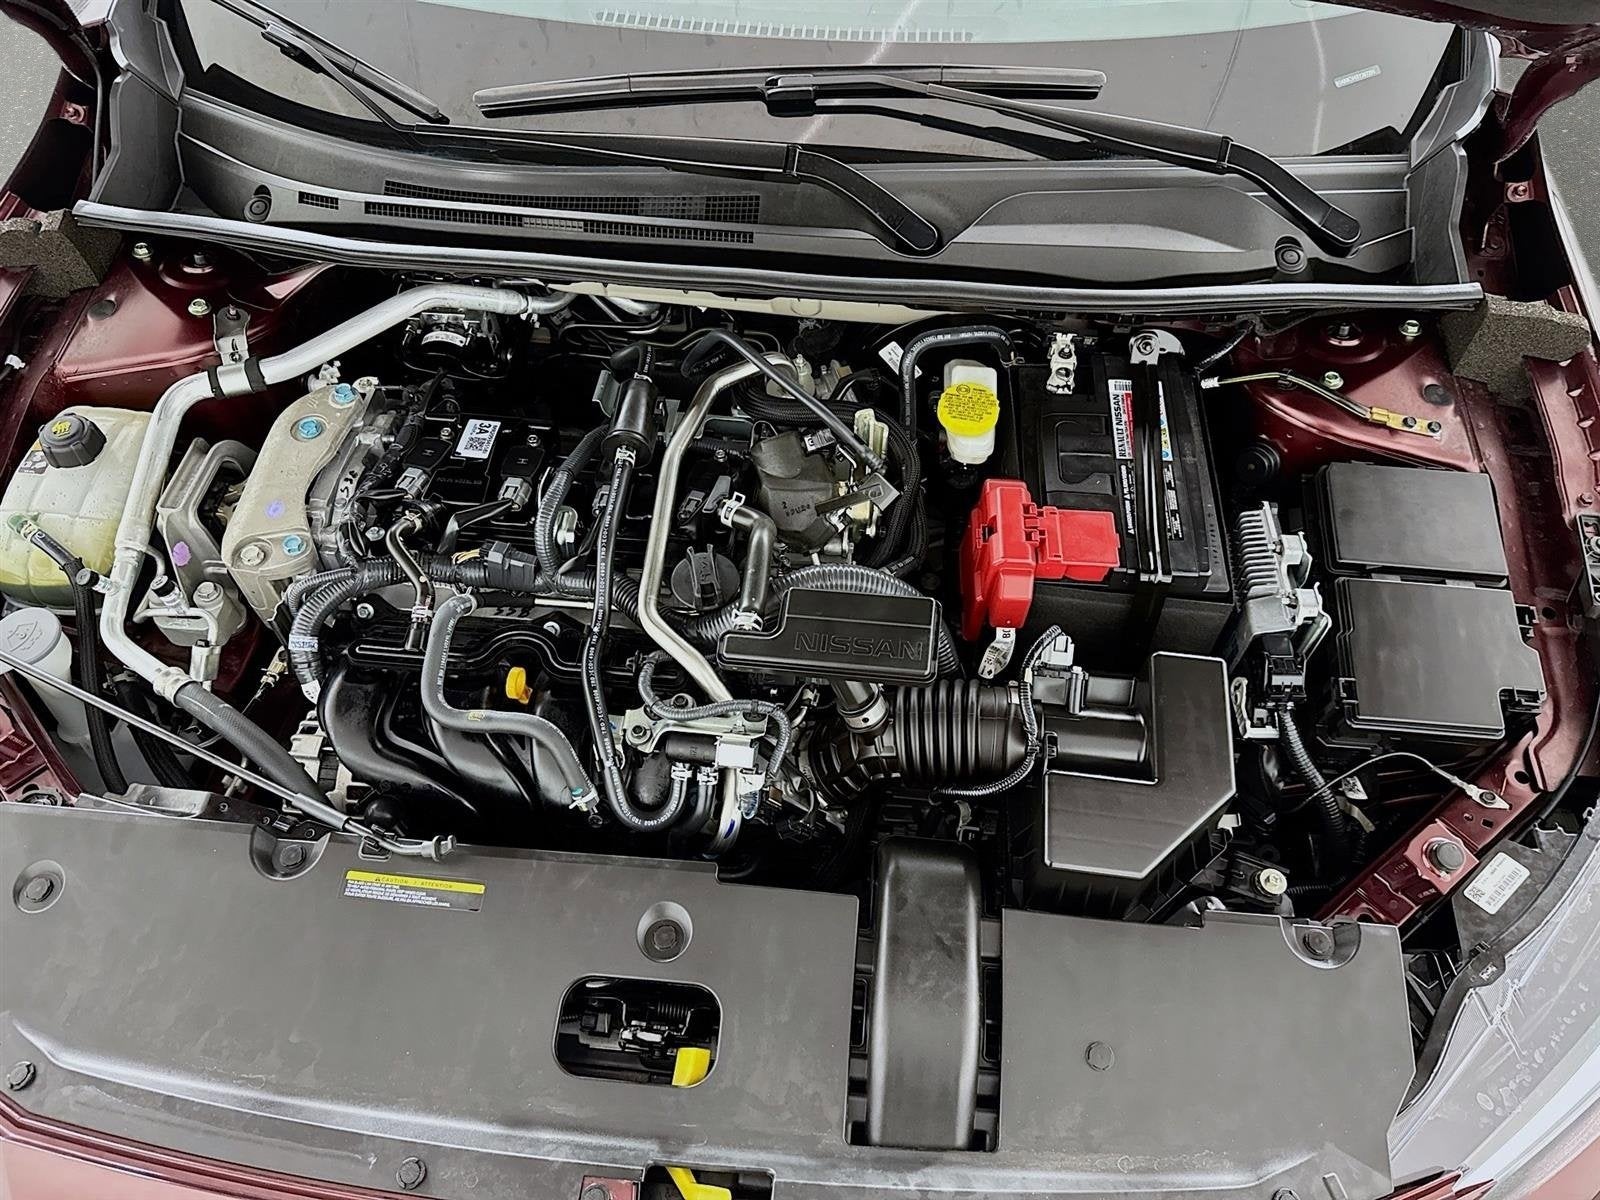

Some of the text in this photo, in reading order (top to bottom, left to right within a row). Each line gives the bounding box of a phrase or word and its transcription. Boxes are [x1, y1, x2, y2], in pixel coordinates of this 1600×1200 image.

[1113, 394, 1123, 427] NISSAN
[475, 422, 489, 435] 3A
[1115, 428, 1127, 457] RENAULT
[794, 631, 923, 661] NISSAN
[381, 877, 408, 885] CAUTION
[420, 881, 453, 889] ATTENTION
